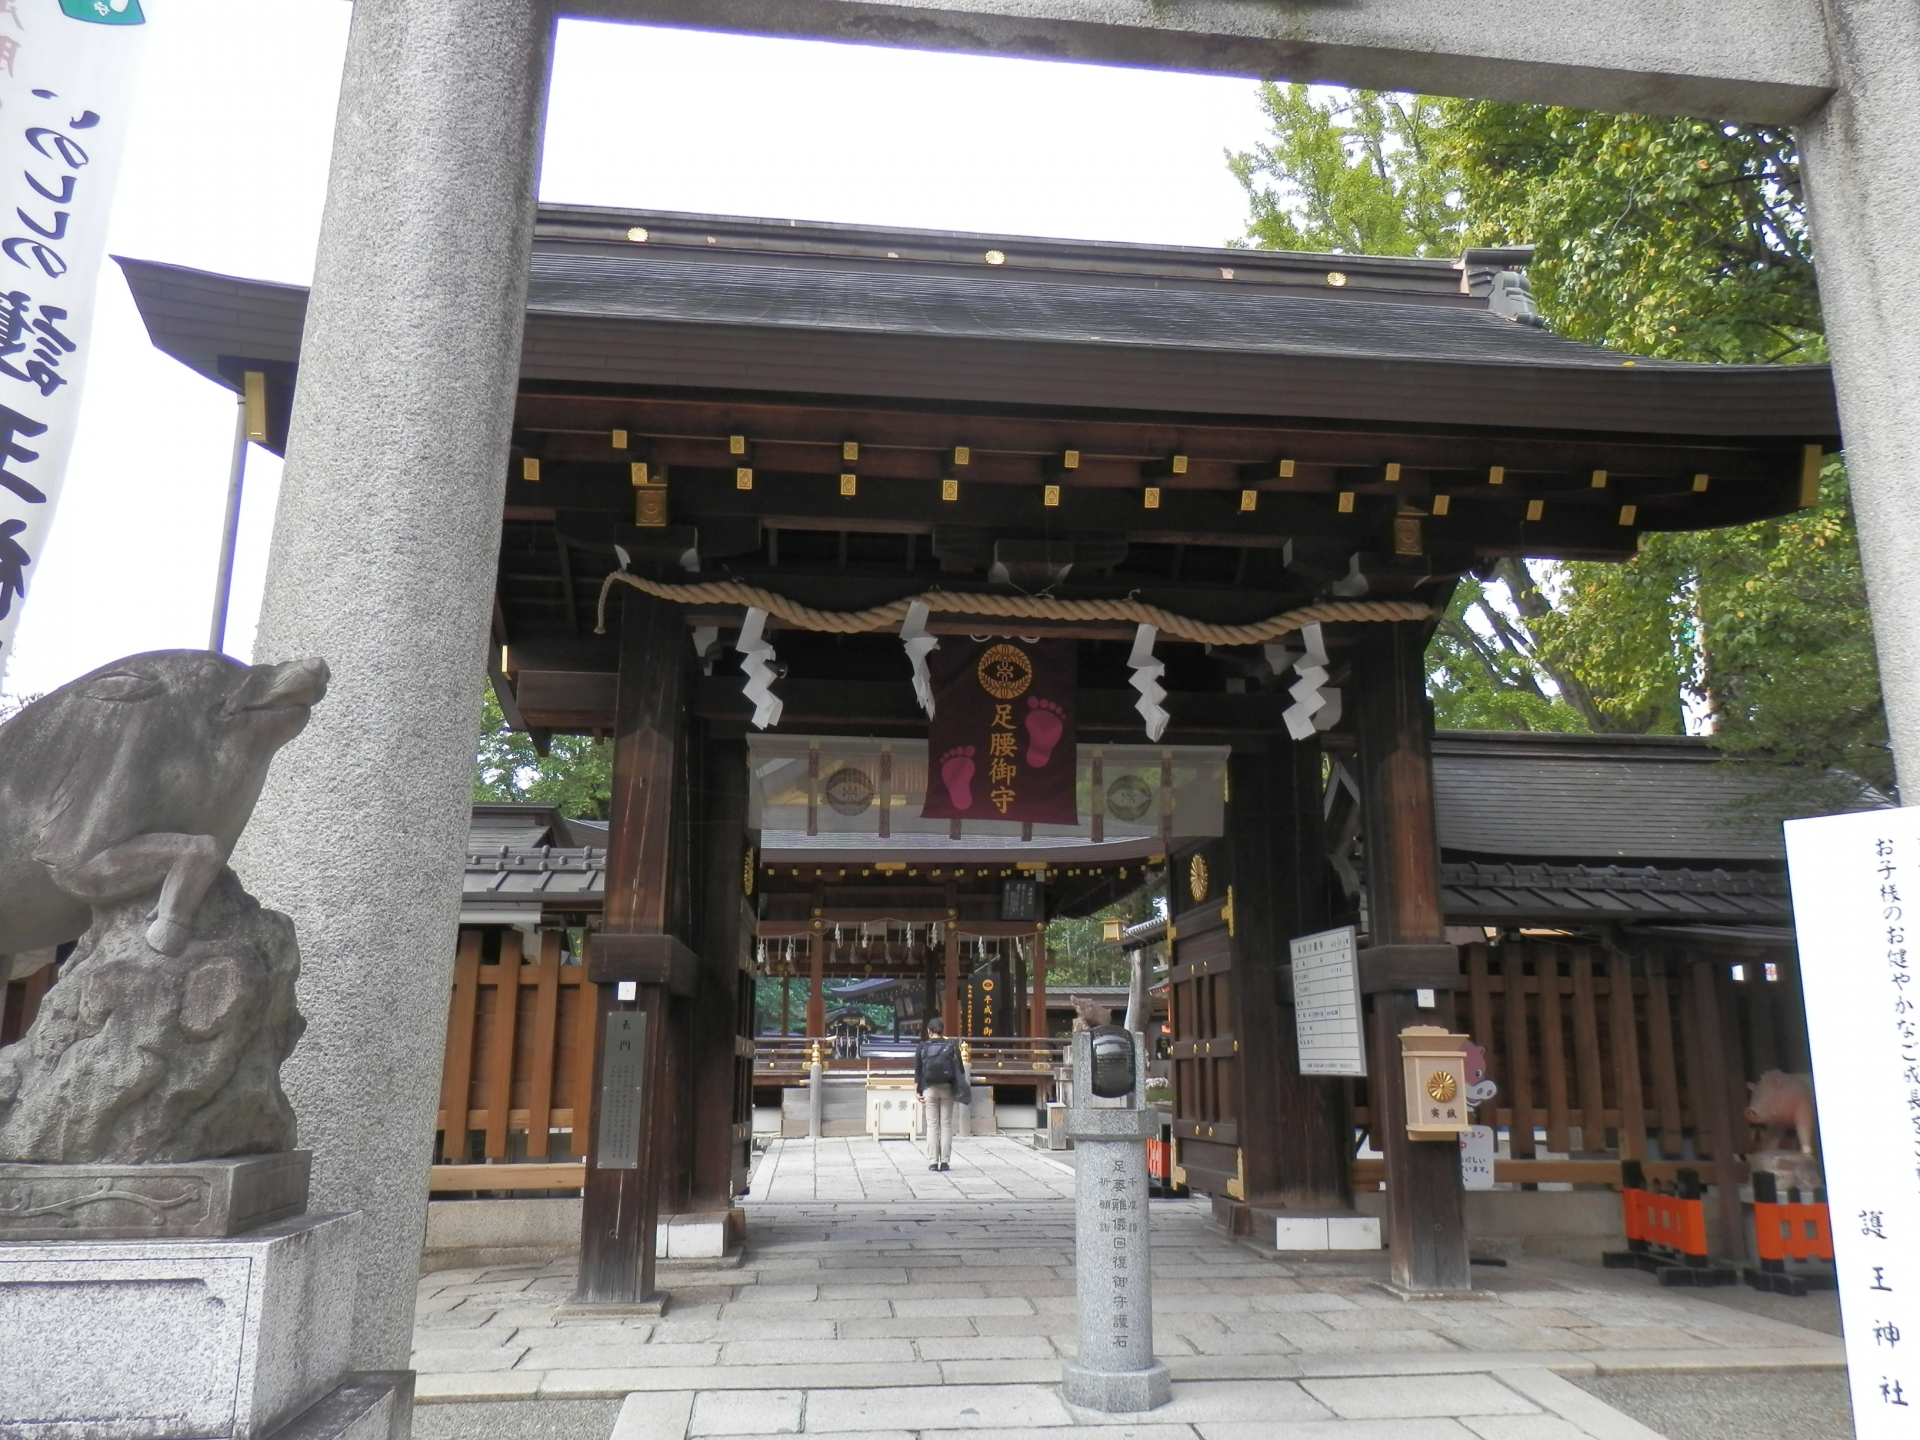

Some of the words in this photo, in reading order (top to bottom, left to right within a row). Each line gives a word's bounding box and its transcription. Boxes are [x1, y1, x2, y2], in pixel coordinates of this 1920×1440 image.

[989, 703, 1018, 814] 足腰御守
[1874, 838, 1920, 1194] お子様のお健やかなご成長を
[1858, 1210, 1909, 1407] 護王神社
